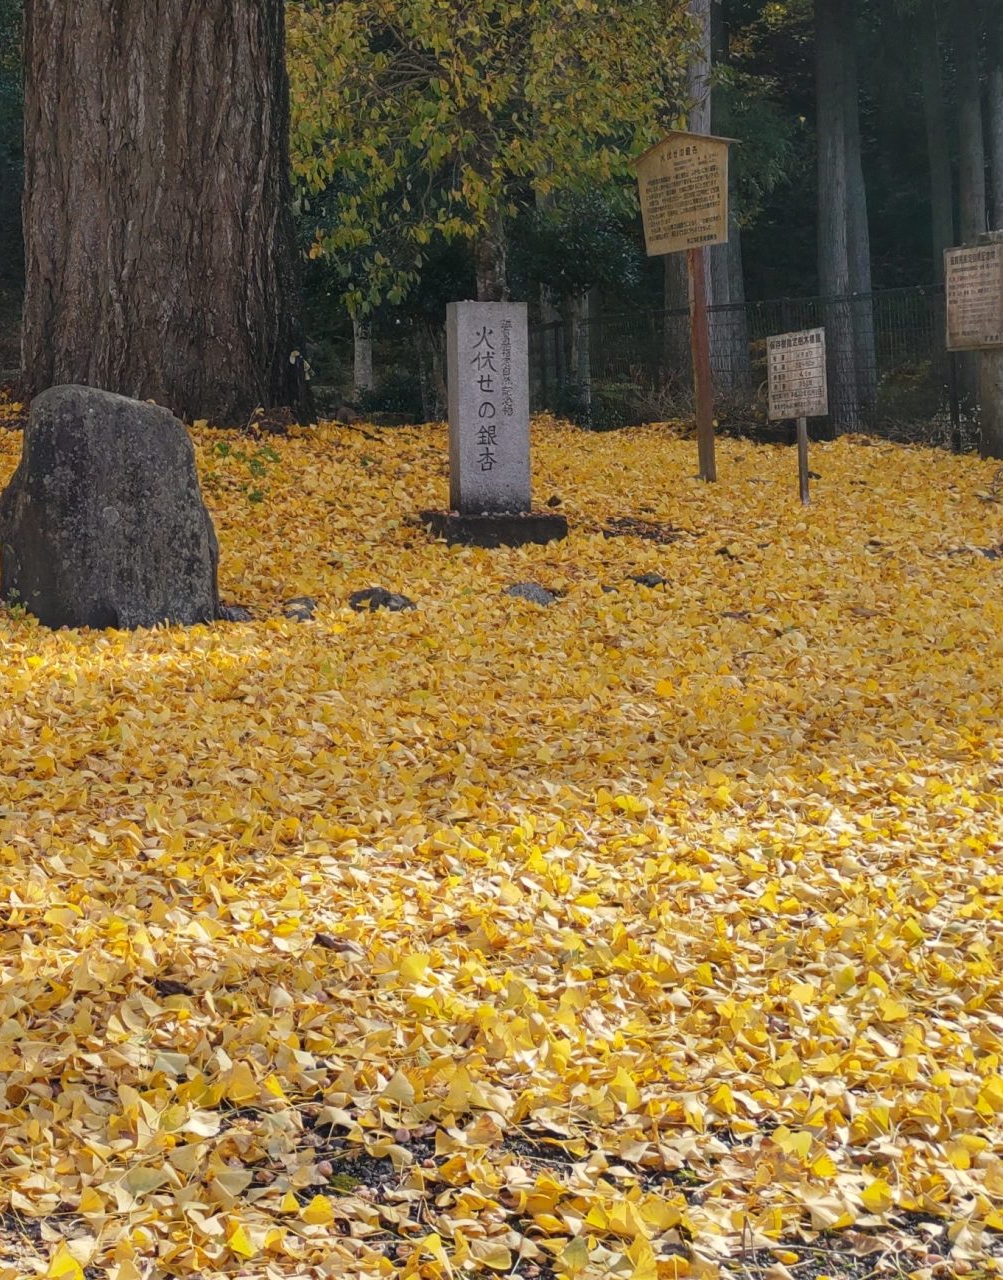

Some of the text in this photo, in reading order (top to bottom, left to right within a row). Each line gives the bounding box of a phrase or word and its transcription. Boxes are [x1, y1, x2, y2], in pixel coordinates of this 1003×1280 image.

[470, 326, 498, 471] 火伏せの銀杏
